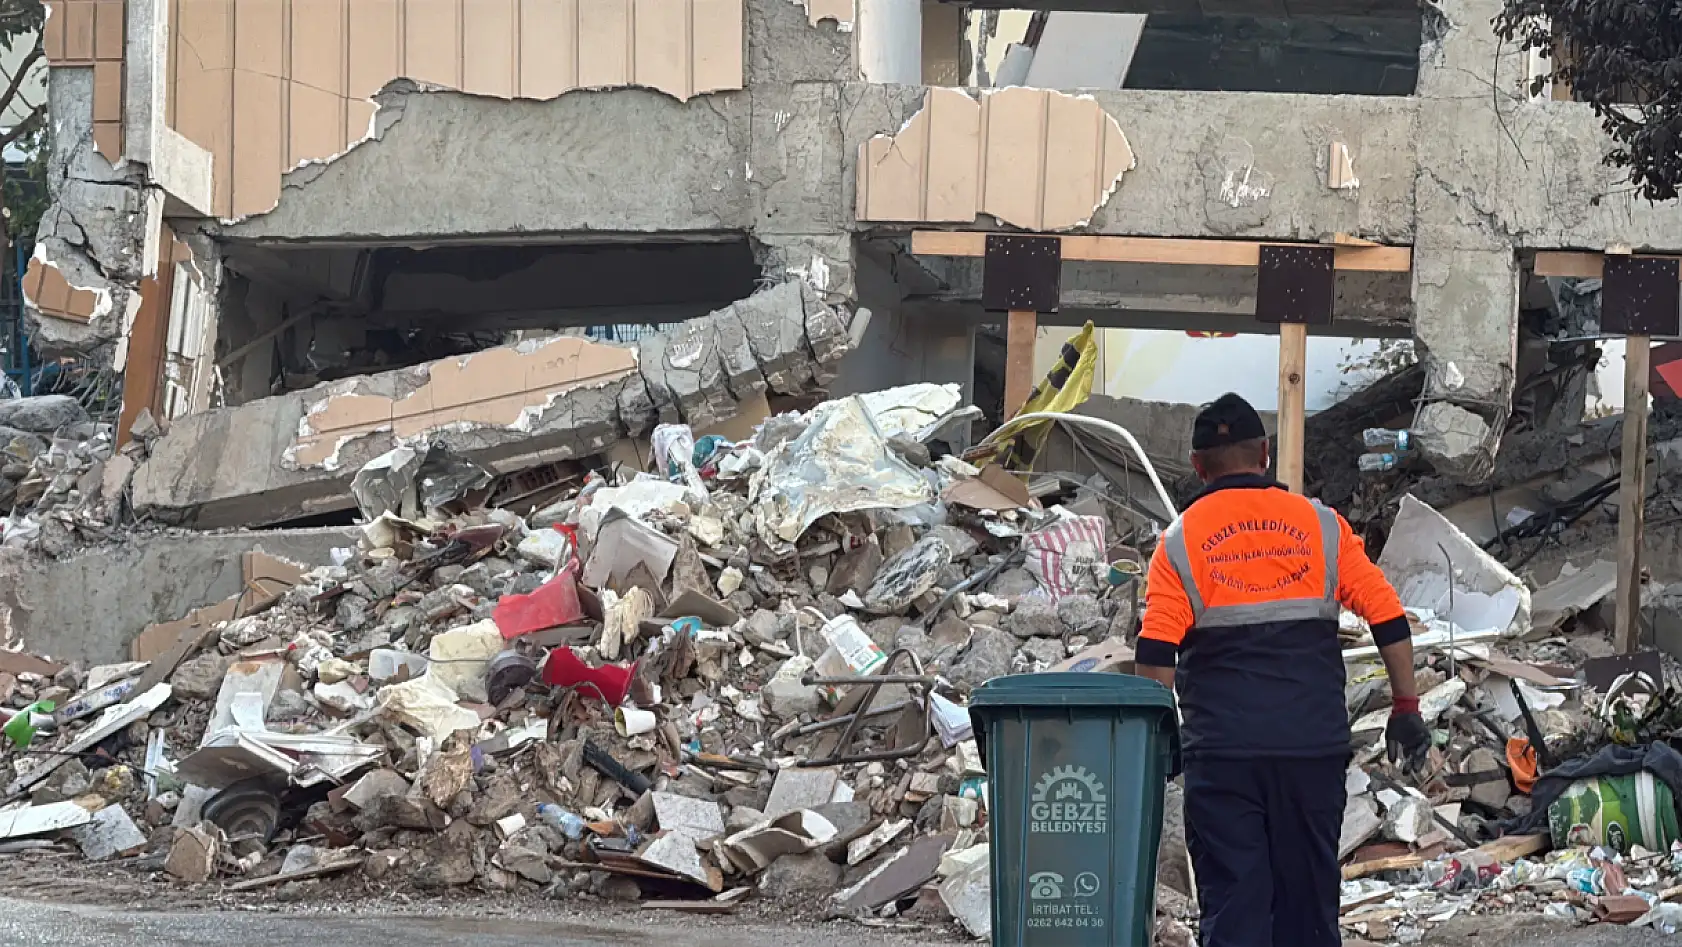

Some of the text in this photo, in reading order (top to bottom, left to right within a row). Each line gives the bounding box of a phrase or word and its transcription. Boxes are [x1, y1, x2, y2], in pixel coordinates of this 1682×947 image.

[1201, 518, 1310, 552] GEBZE BELEDİYESİ
[1031, 802, 1107, 821] GEBZE
[1032, 902, 1072, 915] İRTİBAT
[1027, 917, 1105, 927] 0262 642 04 30
